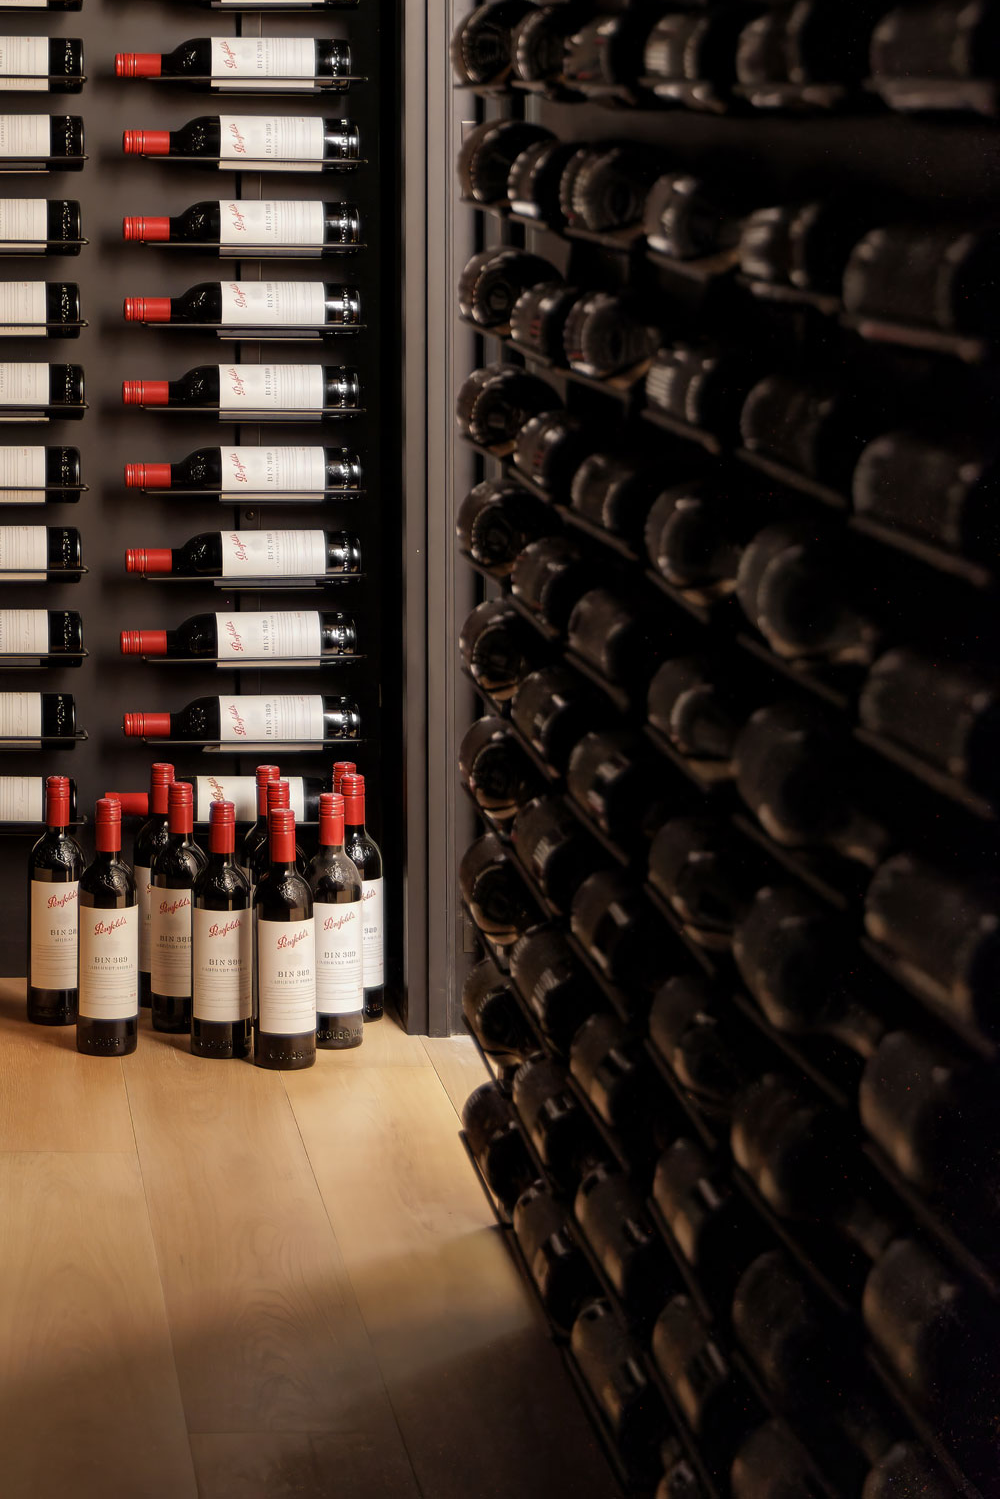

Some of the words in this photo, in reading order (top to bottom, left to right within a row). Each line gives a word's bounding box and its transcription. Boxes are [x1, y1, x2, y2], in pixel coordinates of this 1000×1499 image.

[160, 897, 191, 914] Penfolds
[94, 916, 127, 936] Penfolds
[208, 918, 242, 938] Penfolds
[323, 911, 356, 931] Penfolds
[276, 929, 309, 950] Penfolds
[94, 956, 111, 964] BIN
[209, 958, 226, 966] BIN
[278, 970, 295, 978] BIN
